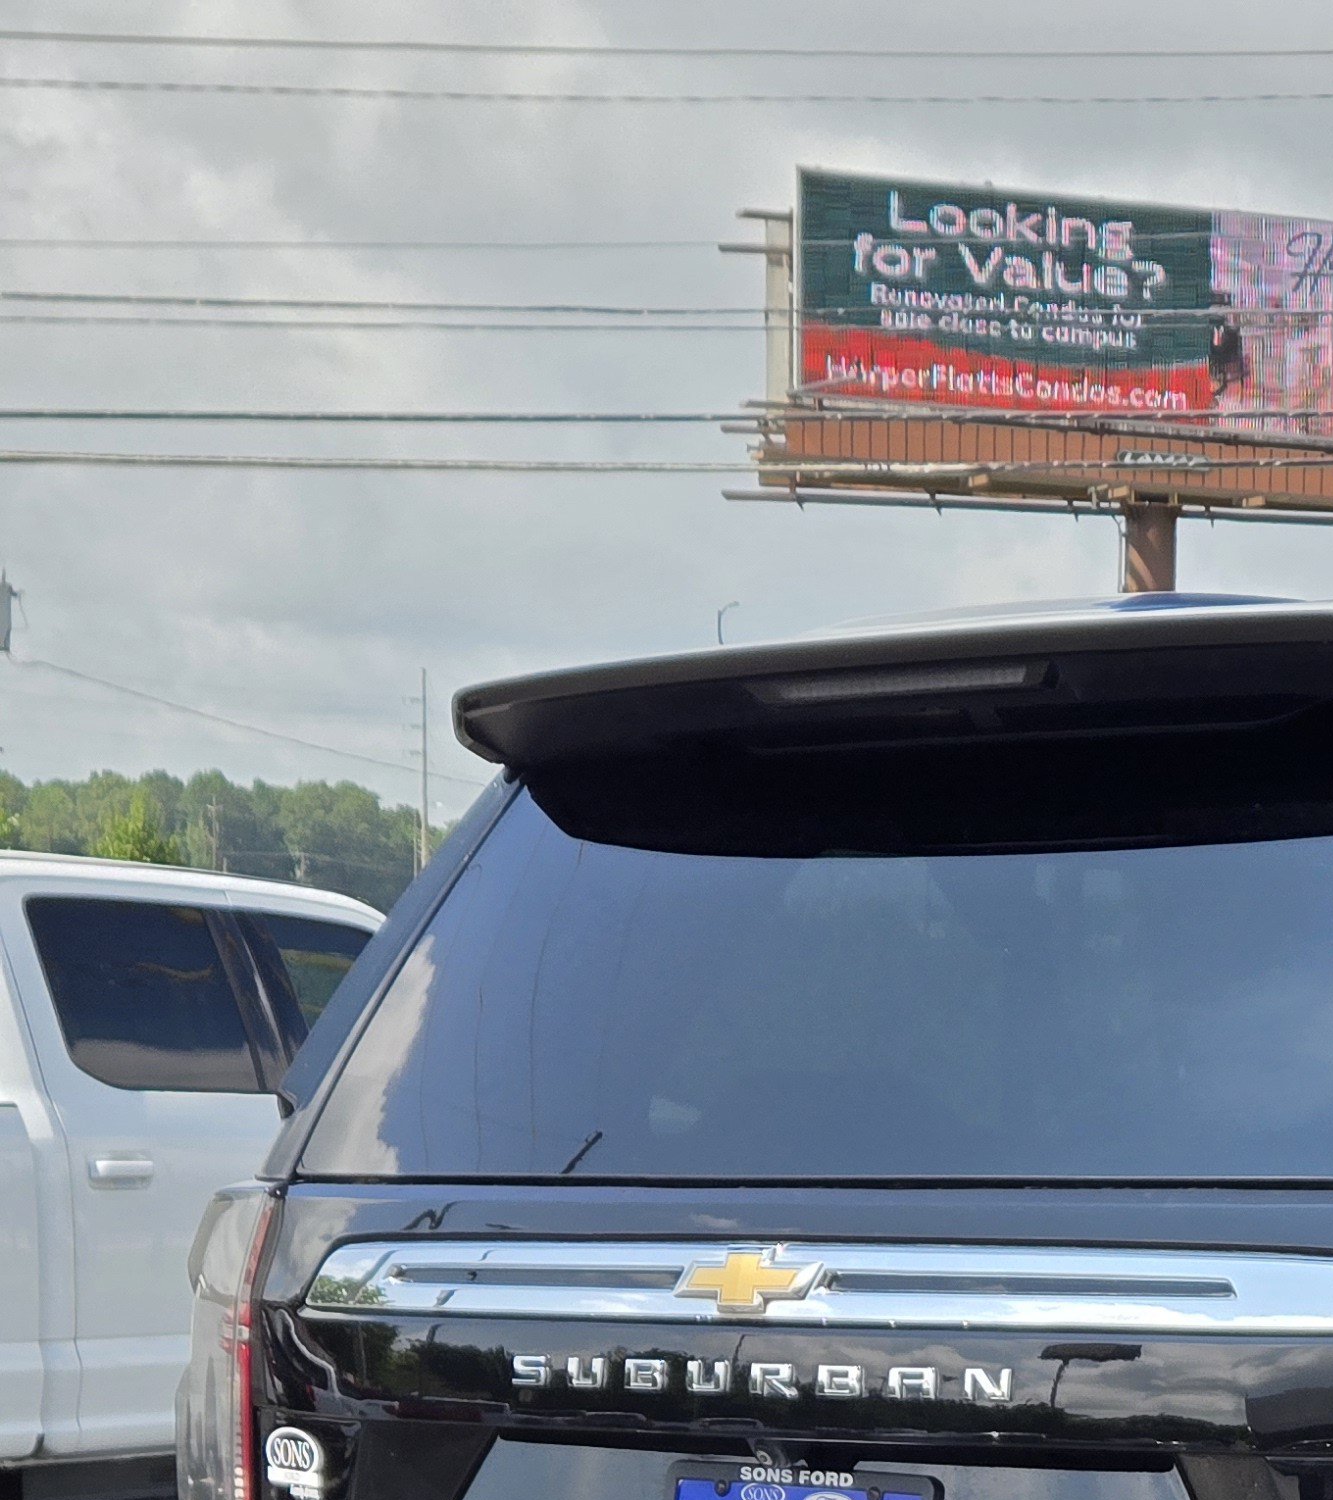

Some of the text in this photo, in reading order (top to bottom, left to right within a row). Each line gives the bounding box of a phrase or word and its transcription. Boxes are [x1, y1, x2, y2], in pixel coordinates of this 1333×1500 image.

[888, 190, 1133, 261] Looking
[854, 232, 1166, 301] for Value?
[1041, 326, 1137, 351] campus
[511, 1354, 1014, 1402] SUBURBAN
[273, 1437, 311, 1470] SONS
[739, 1466, 854, 1488] SONS FORD
